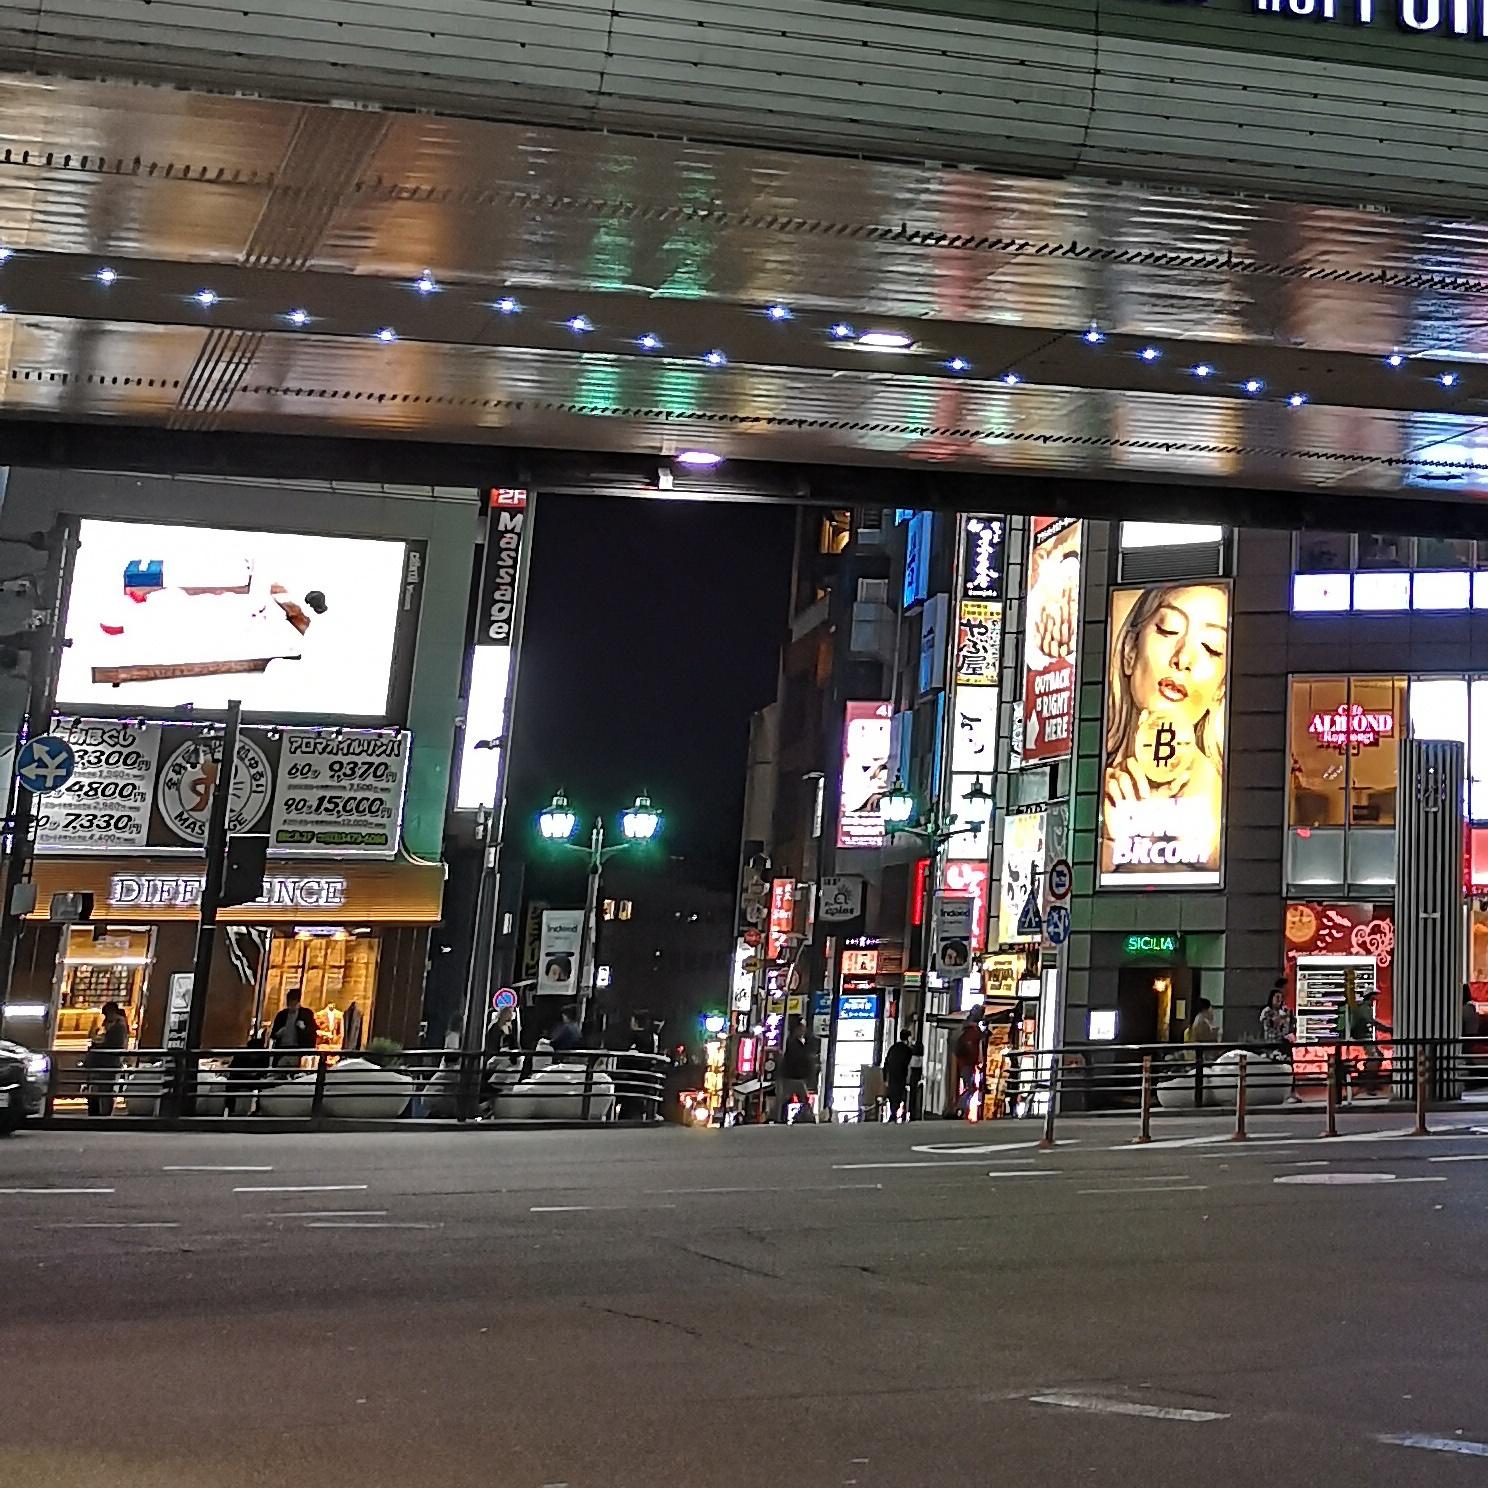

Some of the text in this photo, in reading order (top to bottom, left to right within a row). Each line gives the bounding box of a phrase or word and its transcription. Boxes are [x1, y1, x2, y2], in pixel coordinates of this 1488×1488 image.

[498, 488, 528, 505] 2F
[488, 511, 524, 640] Massage
[956, 616, 991, 676] やぶ屋
[1042, 691, 1071, 718] RIGHT
[1044, 715, 1069, 742] HERE
[174, 811, 248, 836] MASGE
[115, 878, 344, 904] DIFFNCE
[1128, 936, 1174, 950] SICILIA
